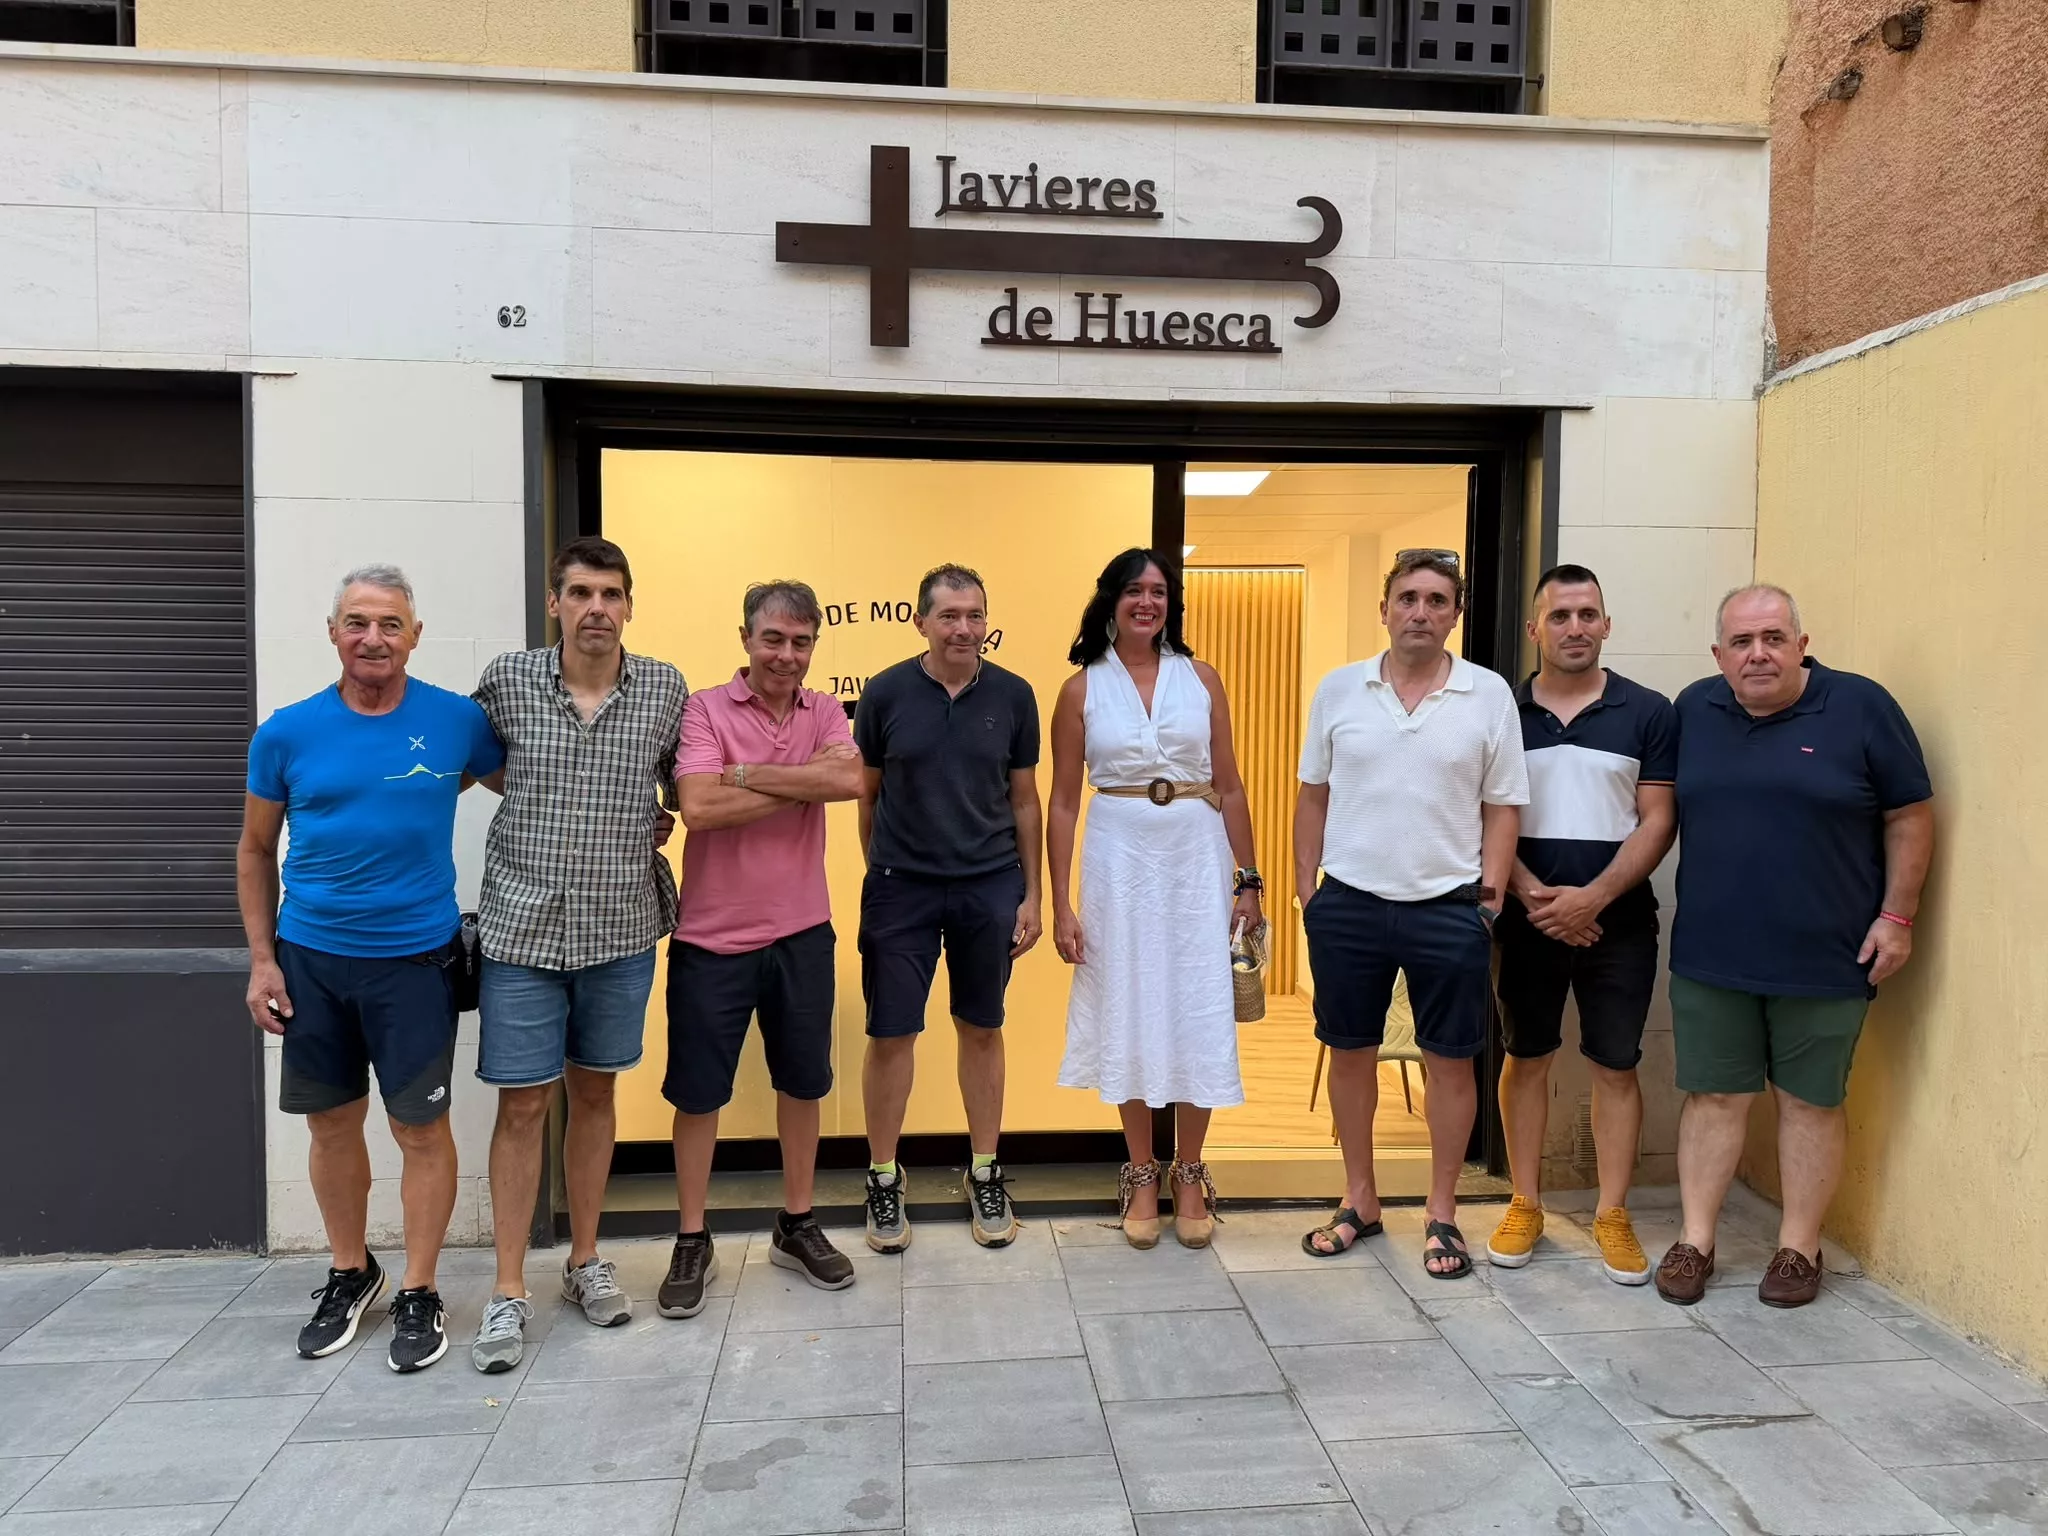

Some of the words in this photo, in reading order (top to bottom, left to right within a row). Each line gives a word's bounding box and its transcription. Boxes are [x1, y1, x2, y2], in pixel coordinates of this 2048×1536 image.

[935, 155, 1158, 217] Javieres
[497, 305, 527, 328] 62
[988, 287, 1054, 341] de
[1073, 291, 1275, 349] Huesca
[825, 602, 859, 626] DE
